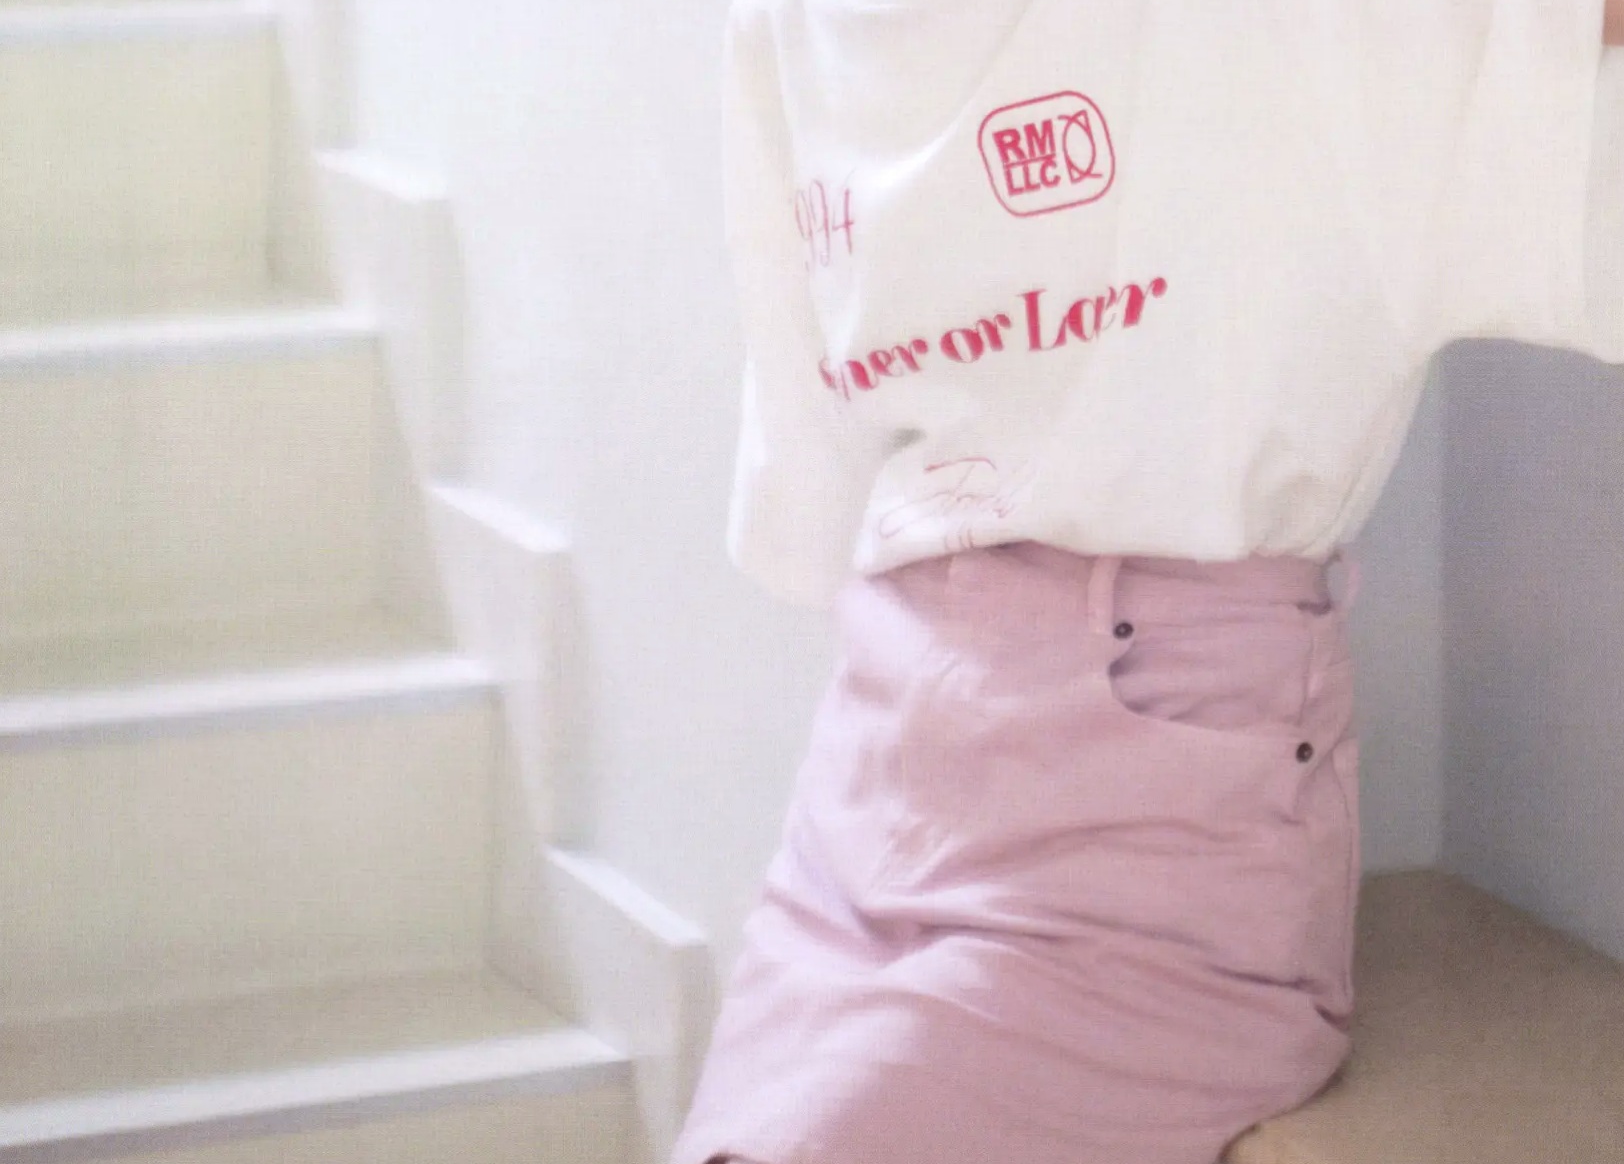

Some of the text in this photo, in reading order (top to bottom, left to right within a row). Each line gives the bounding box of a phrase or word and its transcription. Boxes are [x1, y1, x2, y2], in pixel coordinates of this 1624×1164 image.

[992, 118, 1057, 164] RM
[1004, 158, 1062, 198] LLC
[939, 312, 1012, 364] or
